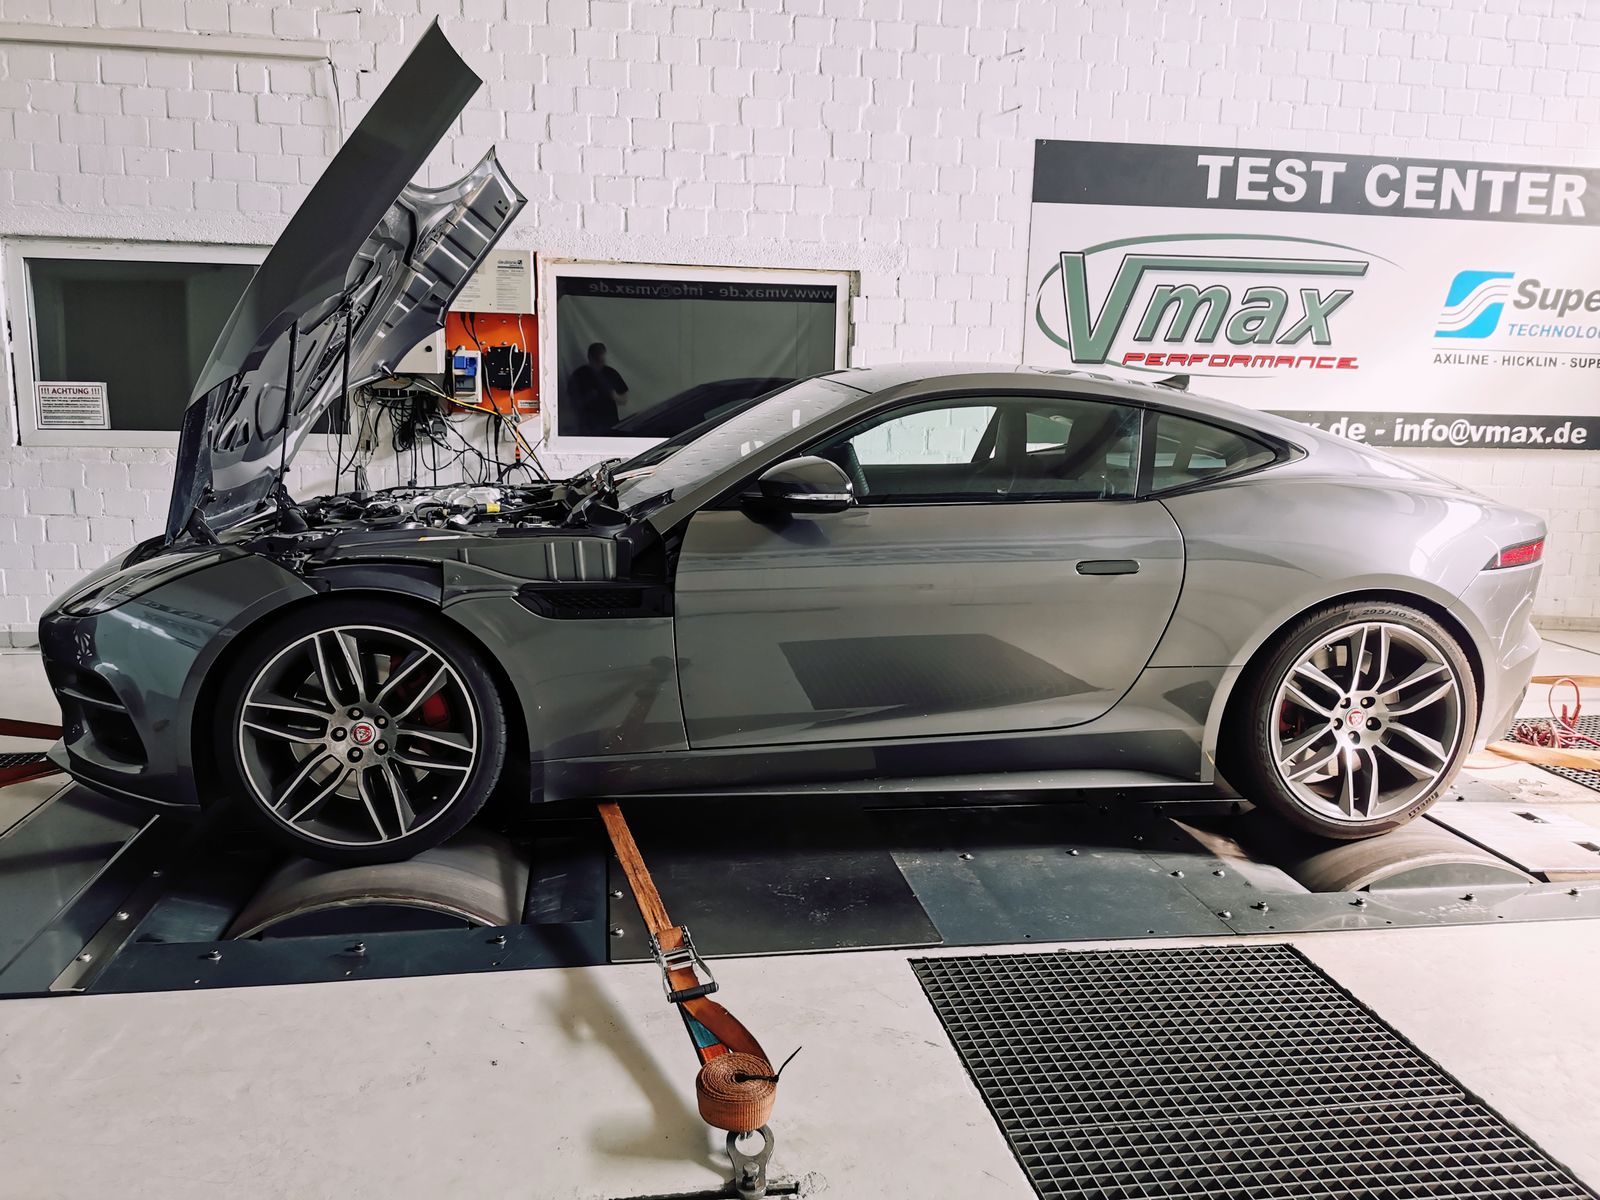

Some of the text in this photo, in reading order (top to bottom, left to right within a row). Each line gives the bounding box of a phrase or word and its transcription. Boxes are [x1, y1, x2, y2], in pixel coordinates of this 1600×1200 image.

[1197, 155, 1588, 217] TEST CENTER
[1060, 252, 1369, 364] Vmax
[1512, 278, 1600, 318] Supe
[1508, 323, 1600, 338] TECHNOLO
[1122, 352, 1360, 369] PERFORMANCE
[1433, 353, 1489, 365] AXILINE
[1502, 355, 1557, 367] HICKLIN
[1393, 418, 1588, 445] info@vmax.de
